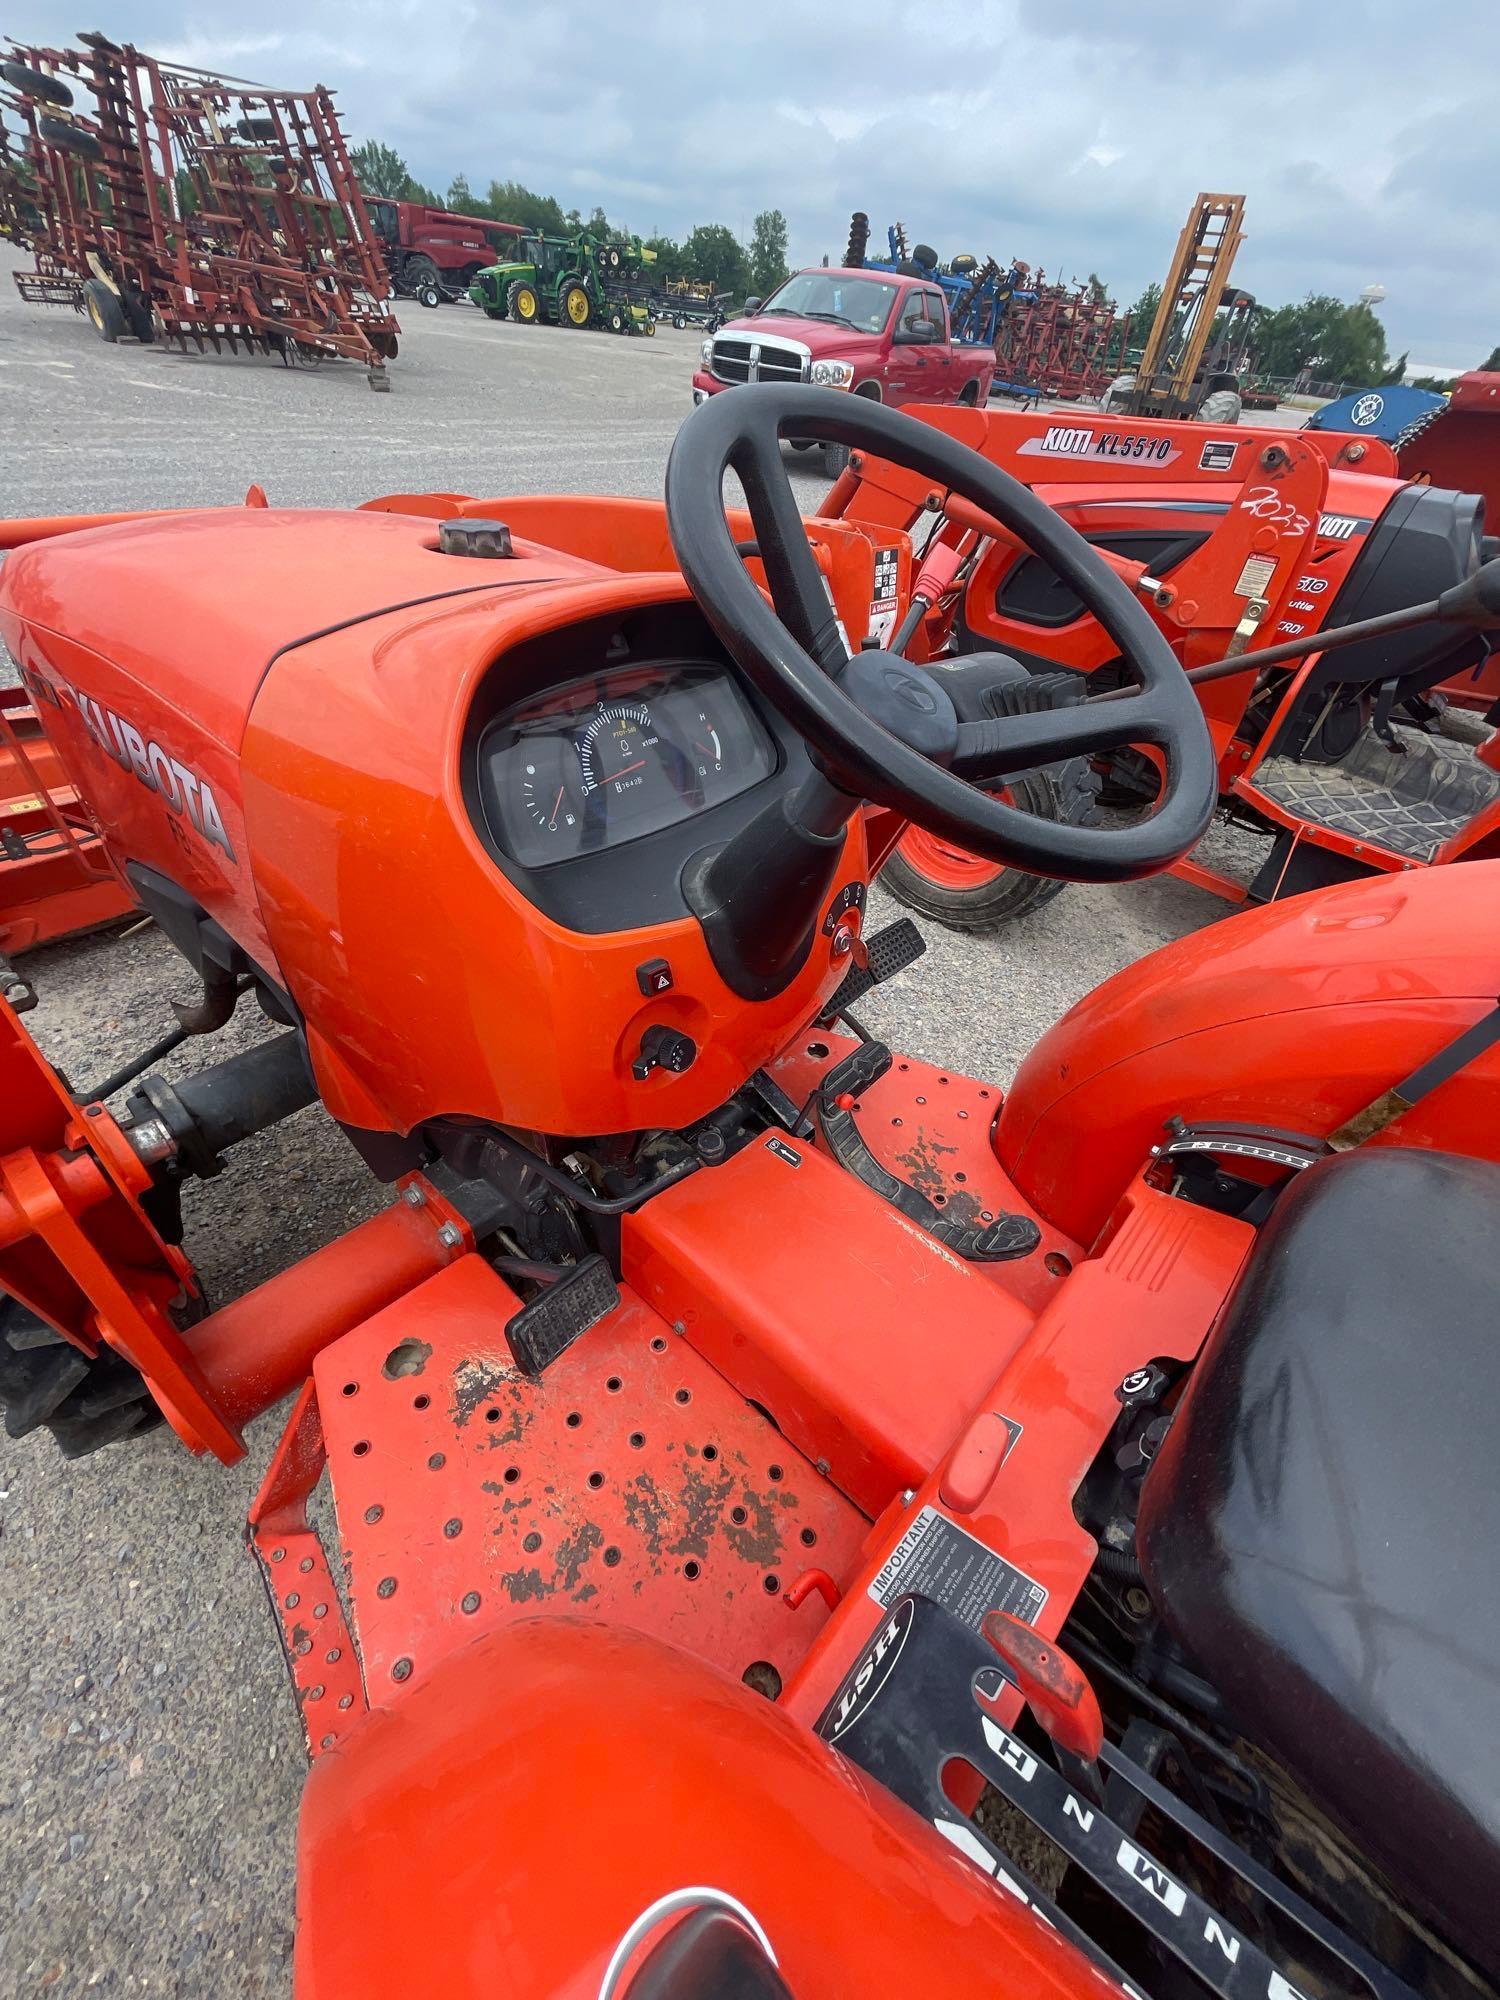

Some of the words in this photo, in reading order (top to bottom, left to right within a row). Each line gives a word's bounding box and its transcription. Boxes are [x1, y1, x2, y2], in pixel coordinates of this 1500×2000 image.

[1041, 427, 1093, 454] KIOTI
[1095, 433, 1172, 460] KL5510
[1240, 486, 1311, 537] 2023
[876, 601, 897, 613] DANGER
[597, 701, 606, 712] 2
[641, 704, 648, 714] 3
[699, 712, 706, 721] H
[574, 741, 581, 751] 1
[66, 682, 238, 866] KUBOTA
[715, 763, 722, 771] C
[581, 785, 589, 796] 0
[872, 1511, 931, 1593] IMPORTANT
[881, 1595, 890, 1606] TO
[886, 1578, 901, 1597] AVOID
[897, 1540, 926, 1580] TRANSMISSION
[922, 1530, 933, 1542] AND
[929, 1516, 942, 1531] SHIFT
[903, 1561, 921, 1586] DAMAGE
[918, 1545, 932, 1563] WHEN
[976, 1554, 992, 1573] parking
[932, 1565, 945, 1581] range
[977, 1560, 997, 1586] procedure
[980, 1577, 994, 1594] speed
[984, 1586, 998, 1603] gears
[833, 1614, 901, 1733] HST
[999, 1736, 1030, 1772] H
[1062, 1793, 1095, 1833] N
[1132, 1854, 1170, 1901] M
[1203, 1915, 1241, 1965] N
